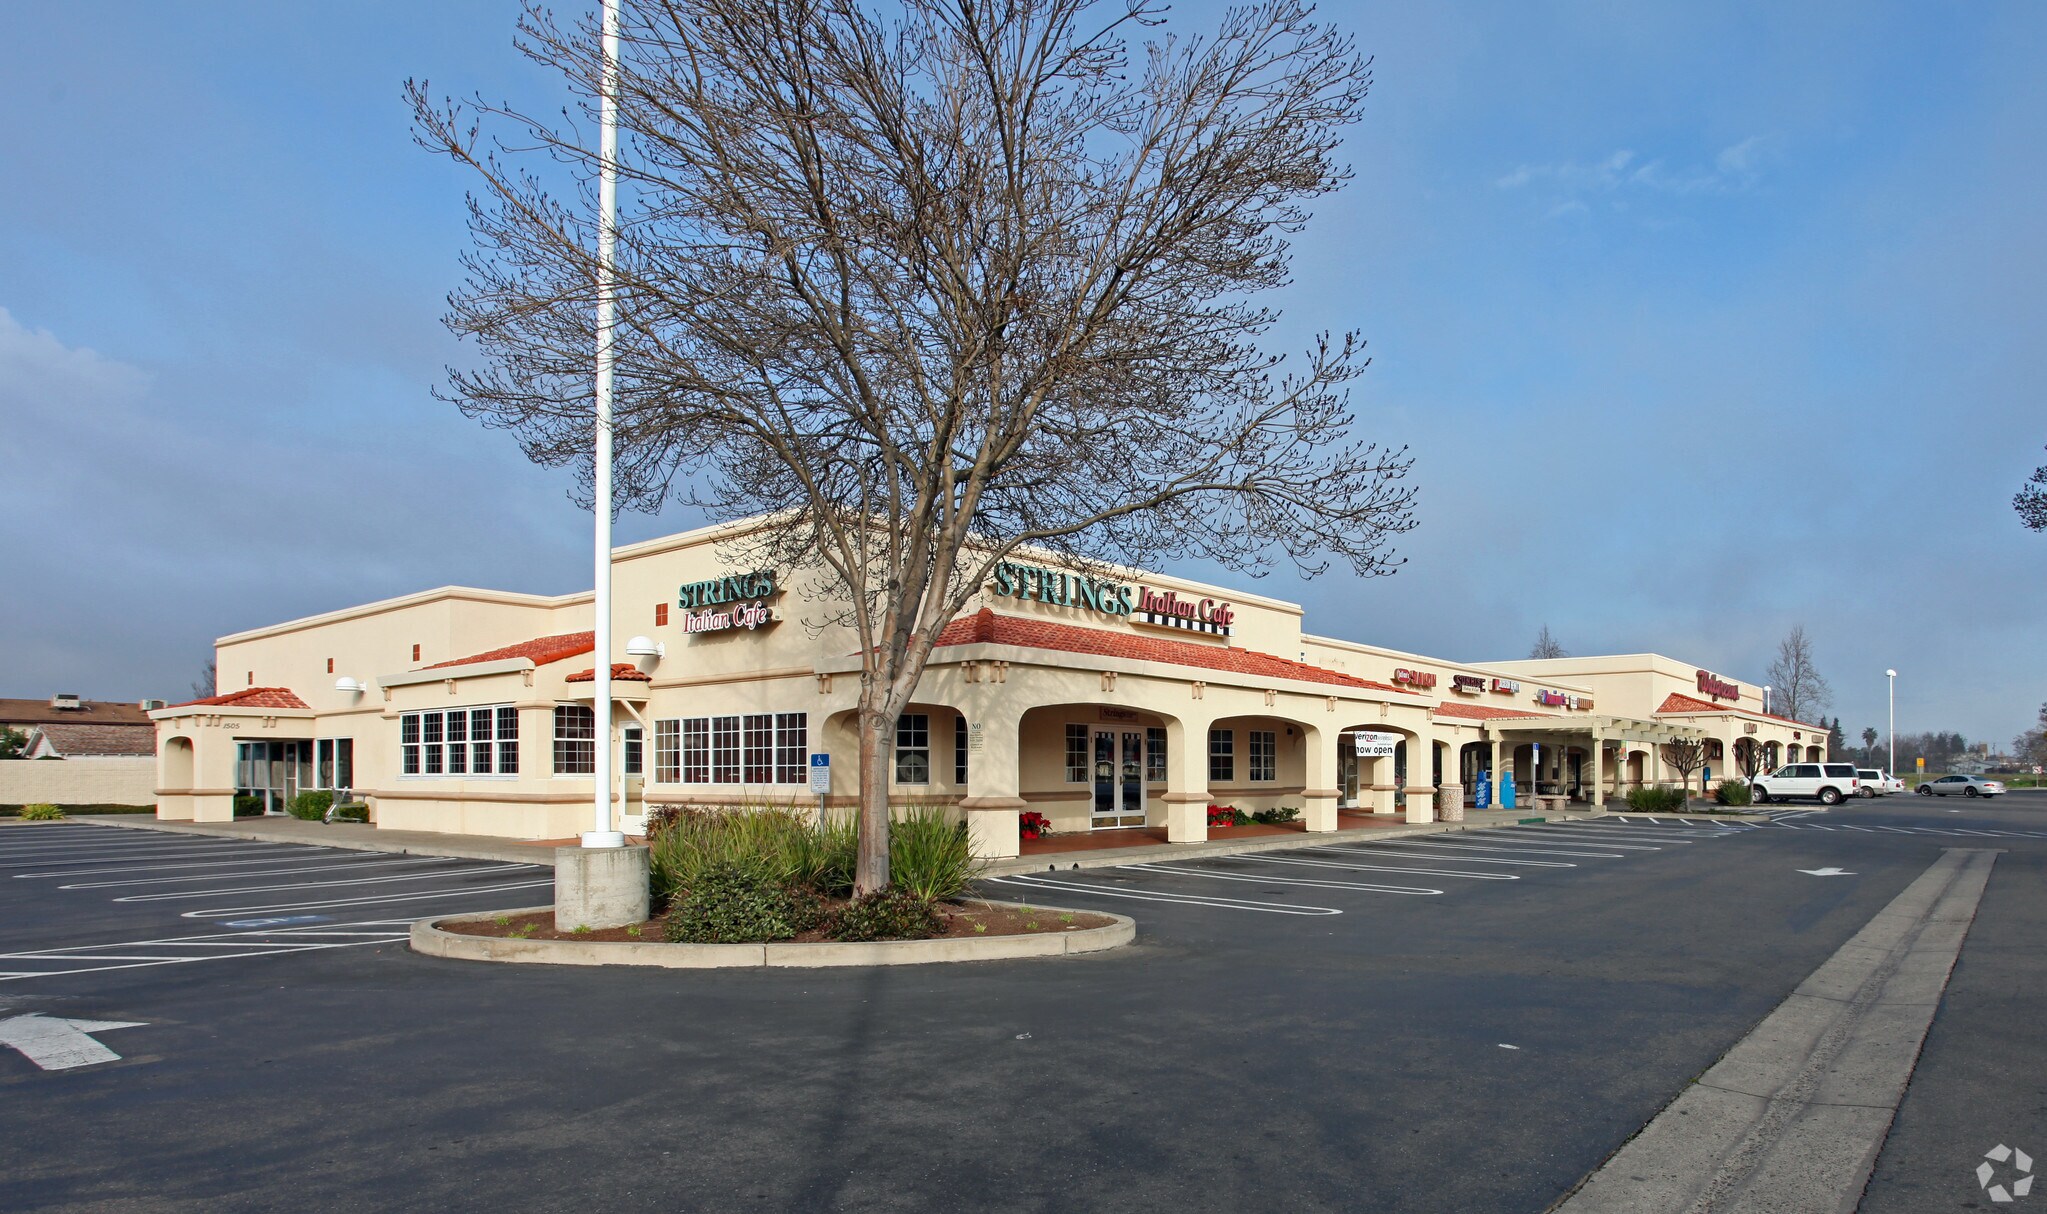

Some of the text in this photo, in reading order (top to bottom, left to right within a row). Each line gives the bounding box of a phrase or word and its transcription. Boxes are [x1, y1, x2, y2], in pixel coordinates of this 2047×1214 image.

[679, 569, 776, 609] STRINGS
[993, 562, 1134, 617] STRINGS
[1138, 585, 1236, 629] Italian Cafe
[683, 600, 768, 634] Italian Cafe
[1356, 746, 1393, 756] now open
